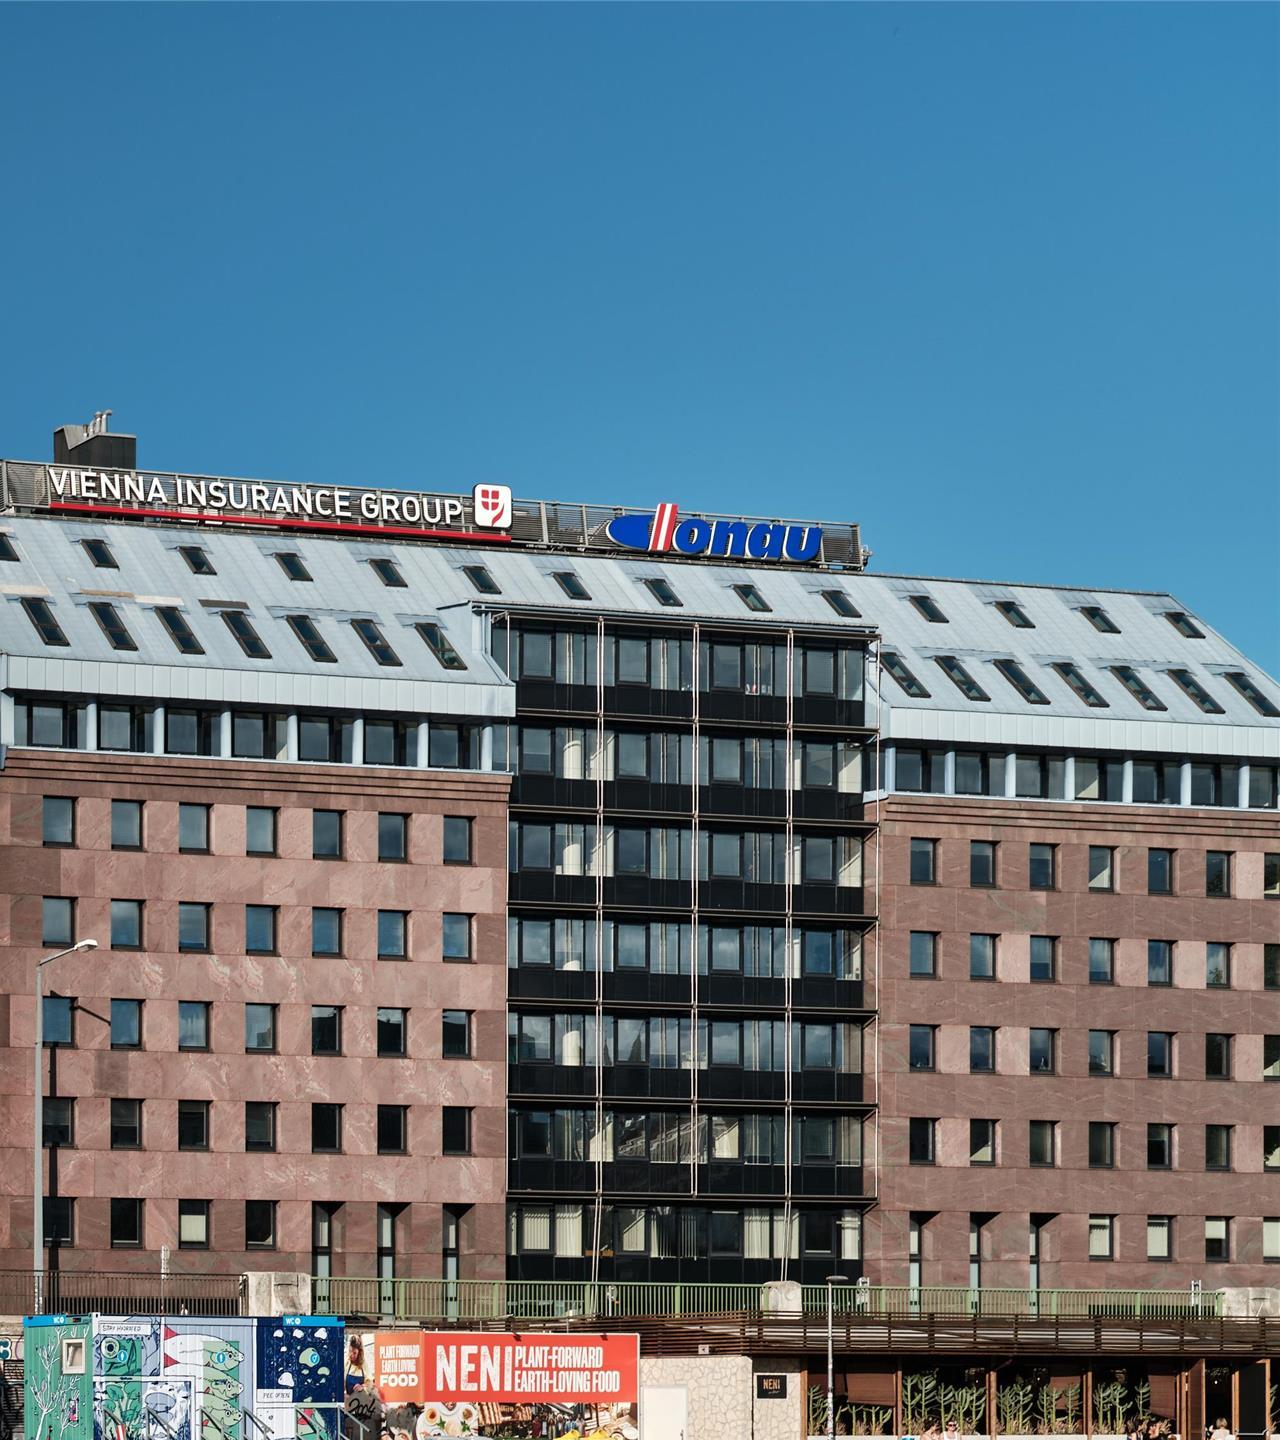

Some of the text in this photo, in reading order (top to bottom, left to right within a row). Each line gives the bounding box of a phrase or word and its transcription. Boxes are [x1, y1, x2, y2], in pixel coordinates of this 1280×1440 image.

[48, 468, 462, 525] VIENNA INSURANCE GROUP
[435, 1344, 513, 1392] NENI
[514, 1345, 604, 1368] PLANT-FORWARD
[380, 1373, 419, 1388] FOOD
[514, 1370, 620, 1393] EARTH-LOVING FOOD
[763, 1378, 781, 1390] NENI
